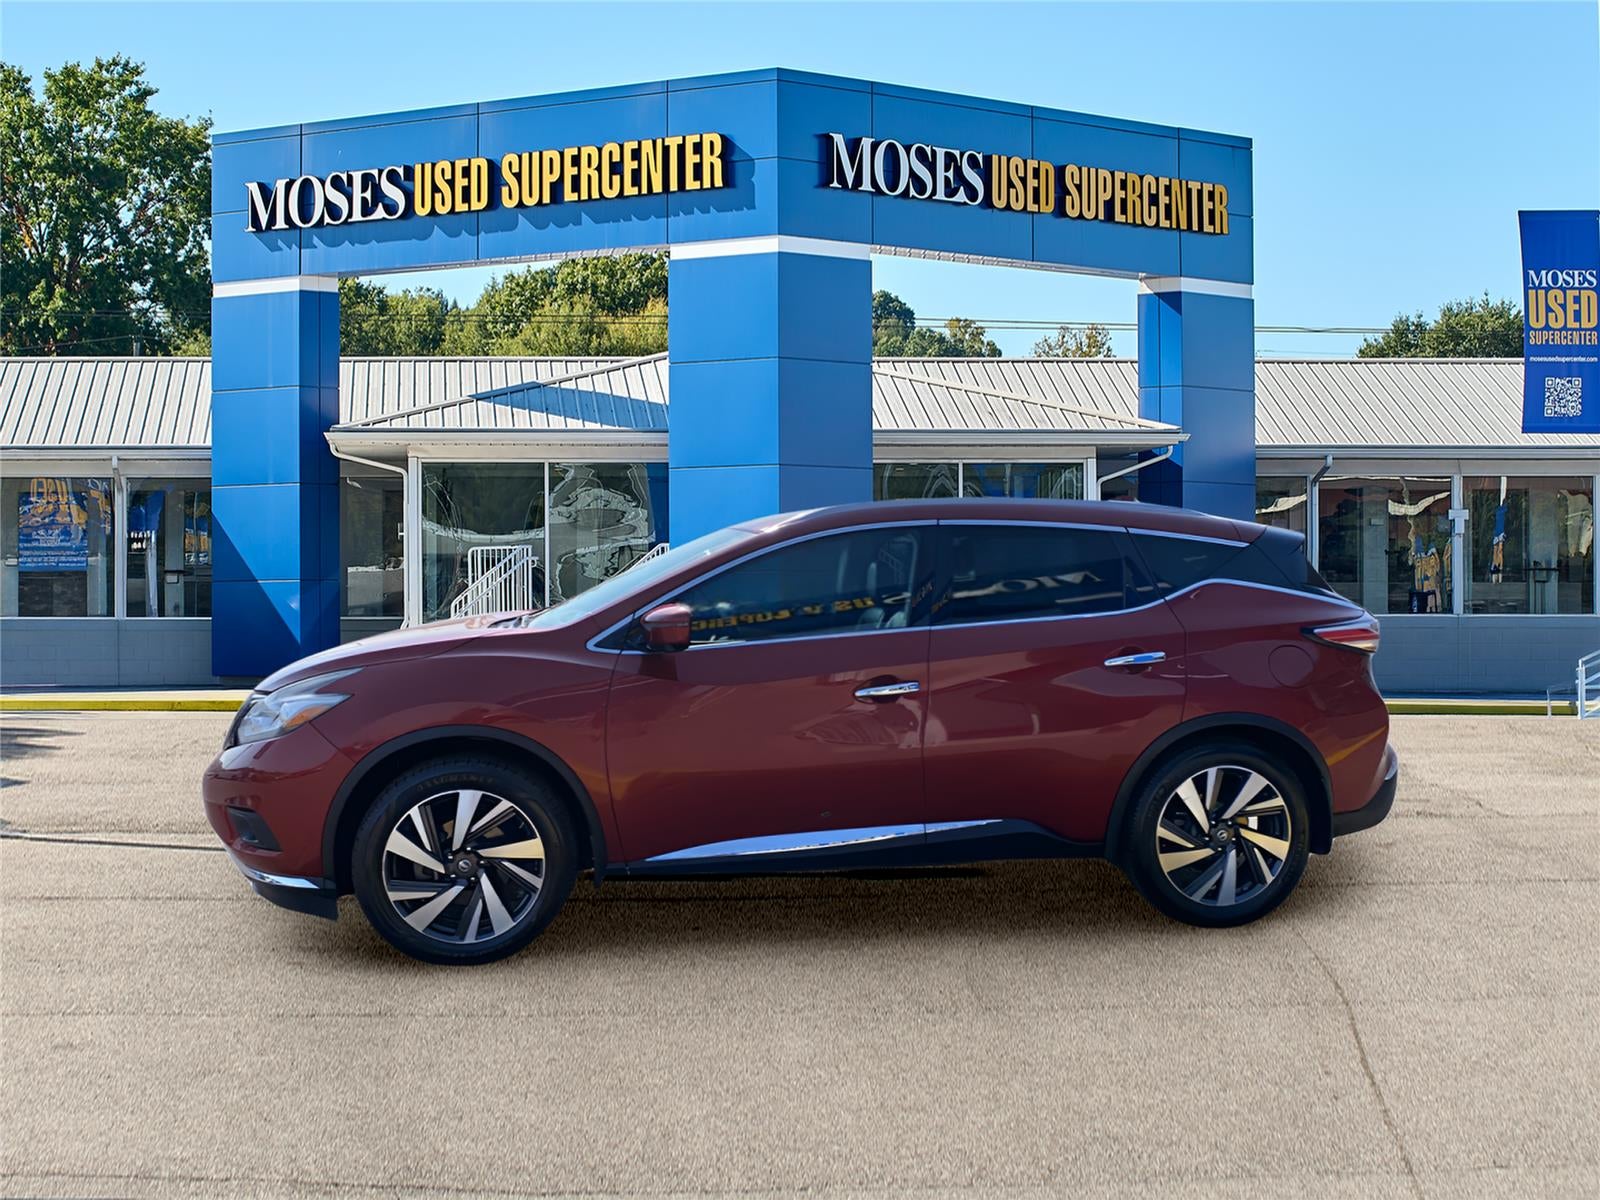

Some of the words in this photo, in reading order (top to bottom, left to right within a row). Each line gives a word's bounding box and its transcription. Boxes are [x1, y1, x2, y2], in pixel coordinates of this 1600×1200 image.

[245, 165, 407, 233] MOSES
[413, 157, 489, 218] USED
[501, 132, 724, 209] SUPERCENTER
[829, 132, 984, 206] MOSES
[991, 153, 1056, 214] USED
[1065, 163, 1230, 235] SUPERCENTER
[1528, 270, 1597, 288] MOSES
[1529, 290, 1598, 329] USED
[1530, 331, 1598, 345] SUPERCENTER
